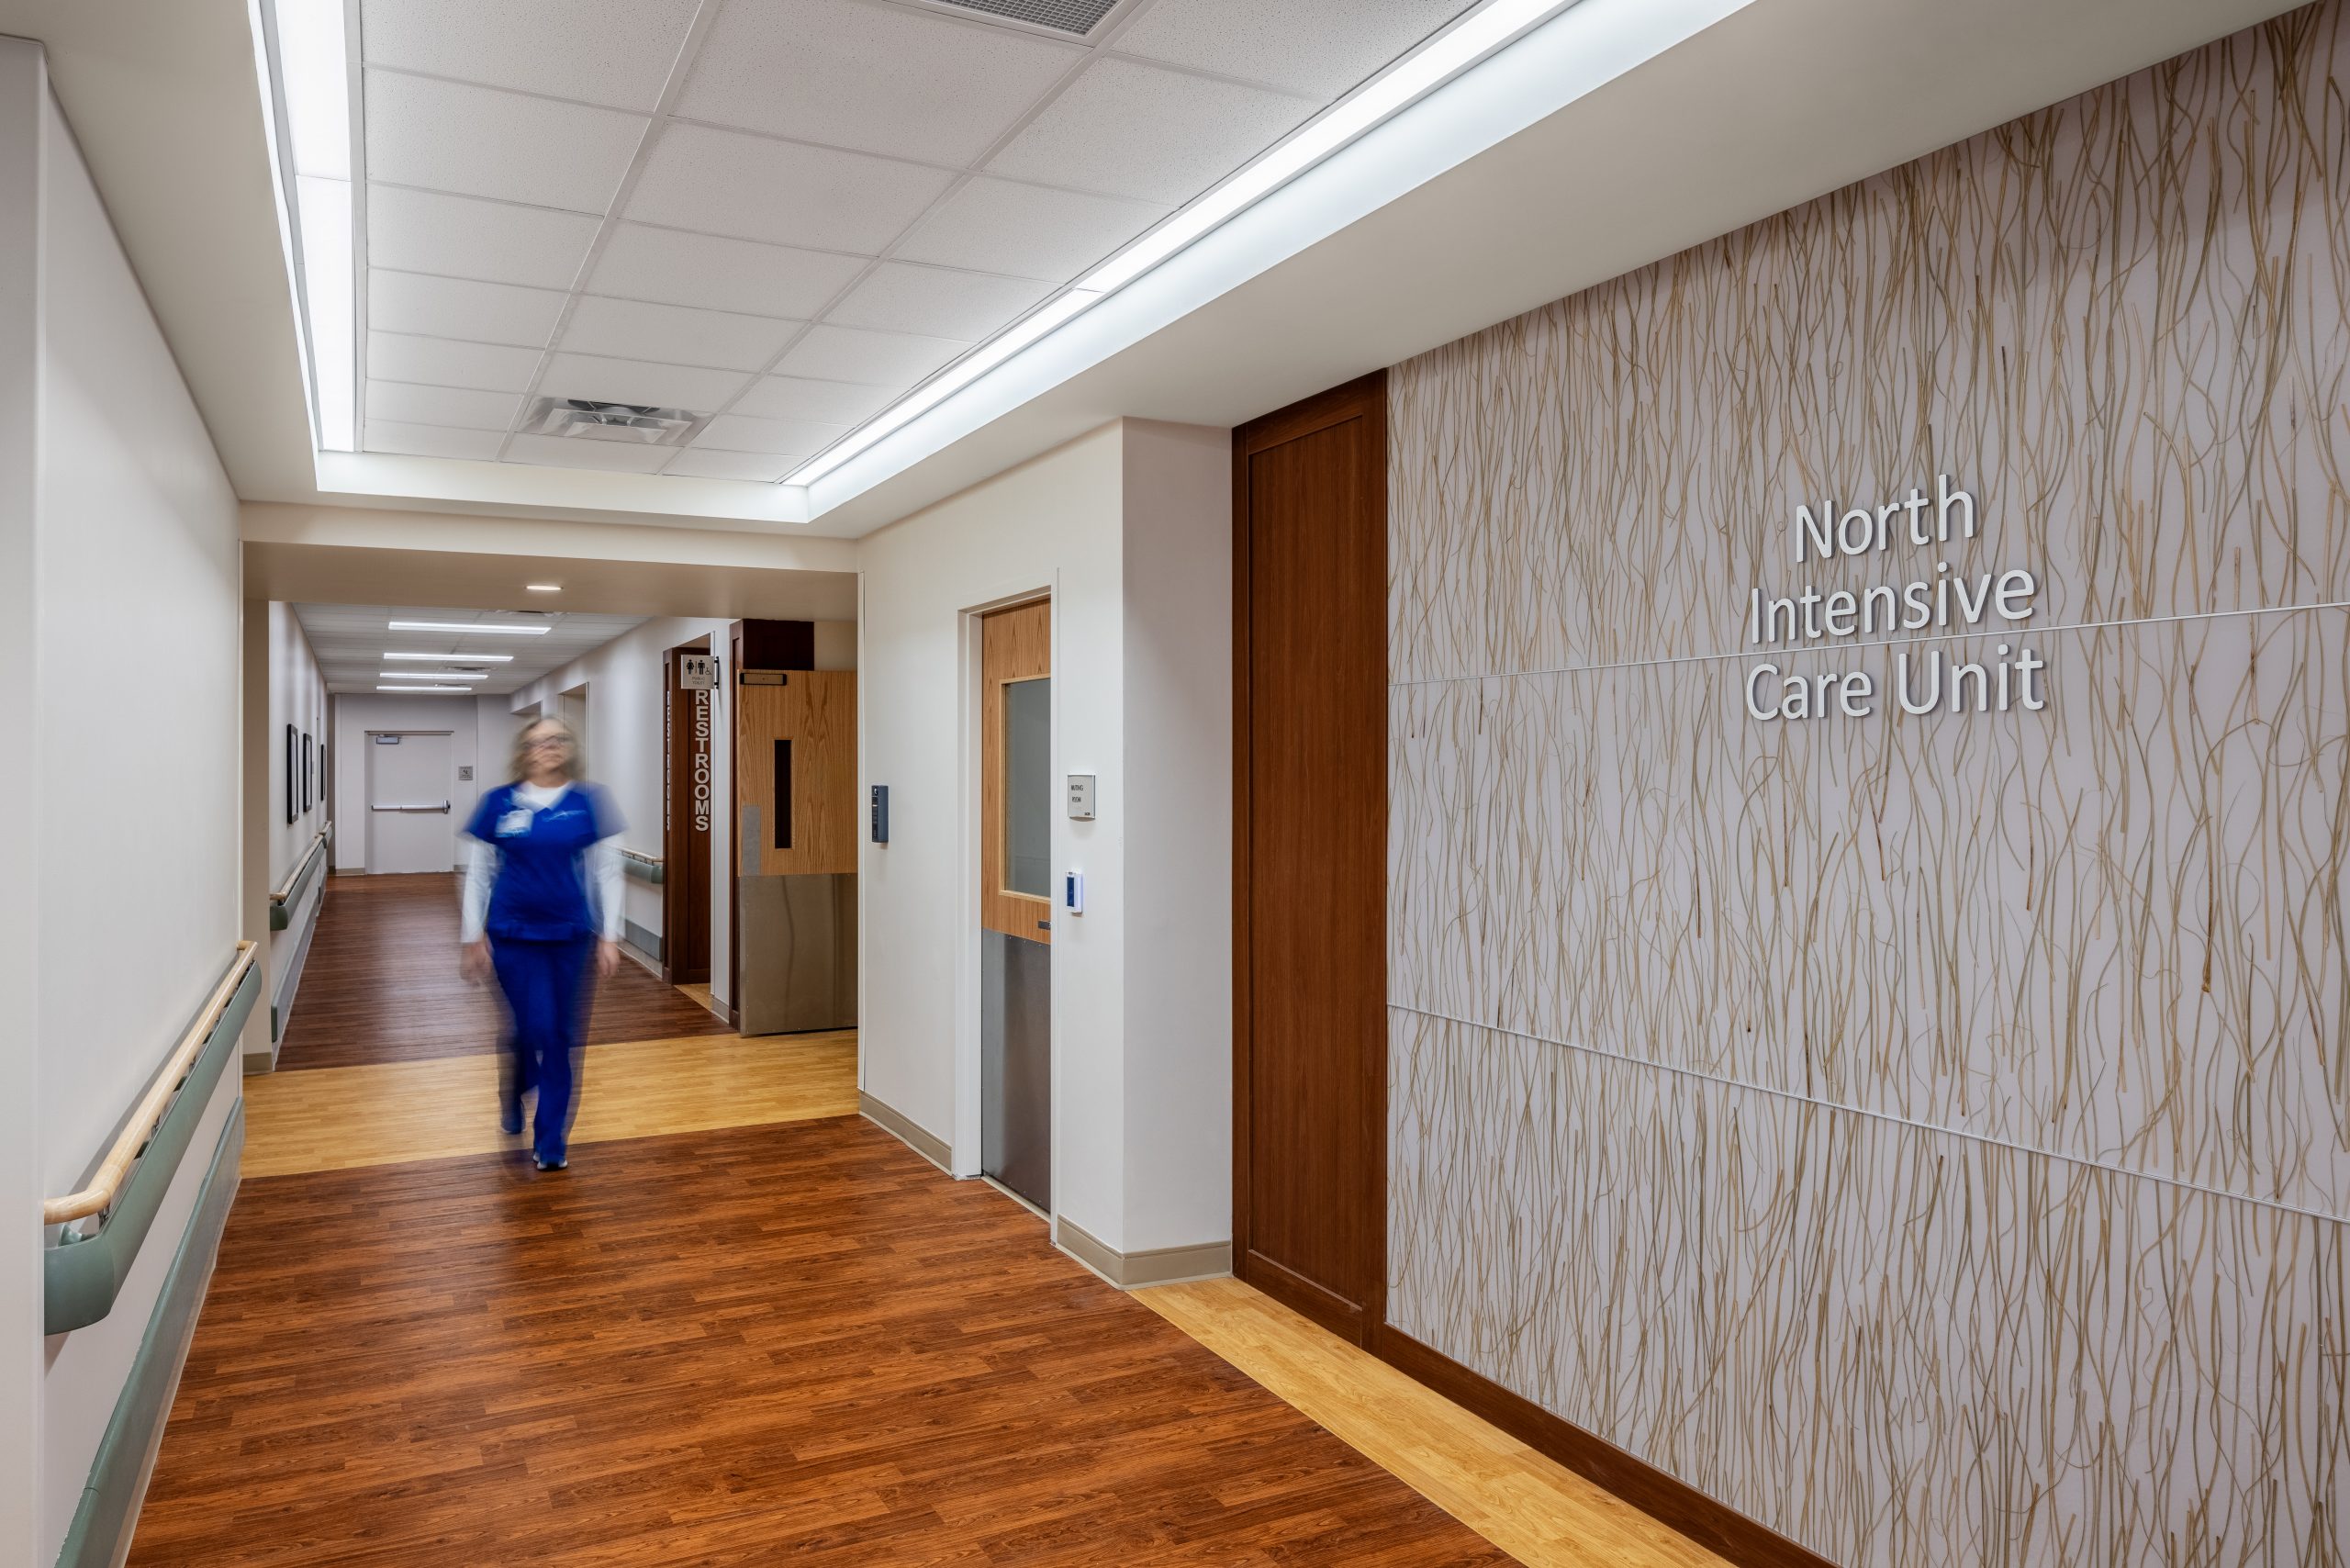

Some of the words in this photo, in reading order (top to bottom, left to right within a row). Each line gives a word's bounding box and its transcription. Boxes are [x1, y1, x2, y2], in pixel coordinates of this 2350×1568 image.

[1796, 474, 1975, 563] North
[1751, 561, 2035, 644] Intensive
[1746, 663, 1873, 721] Care
[1898, 644, 2045, 715] Unit
[694, 689, 711, 832] RESTROOMS
